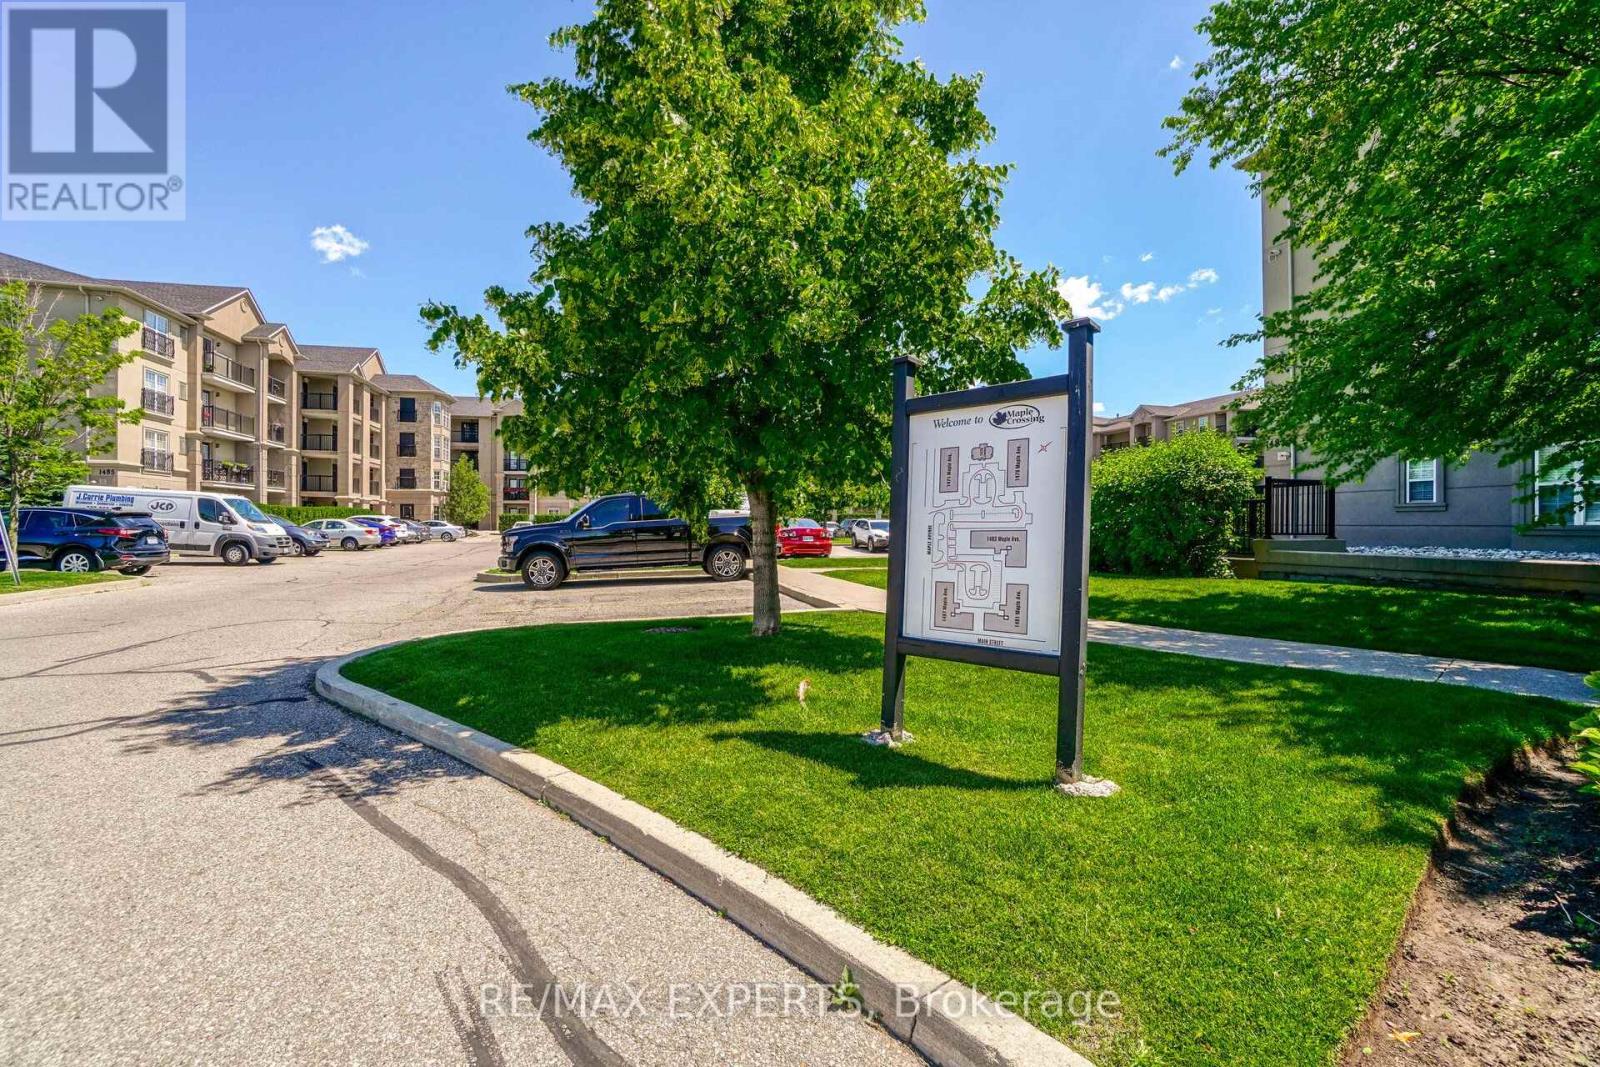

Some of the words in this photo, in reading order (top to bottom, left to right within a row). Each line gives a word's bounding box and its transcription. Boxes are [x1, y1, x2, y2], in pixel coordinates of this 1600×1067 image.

[1007, 408, 1034, 418] Maple
[933, 417, 972, 430] Welcome
[974, 415, 984, 424] to
[1006, 414, 1046, 425] Crossing
[105, 495, 135, 504] Plumbing
[150, 501, 174, 511] JCP
[997, 535, 1010, 543] Maple
